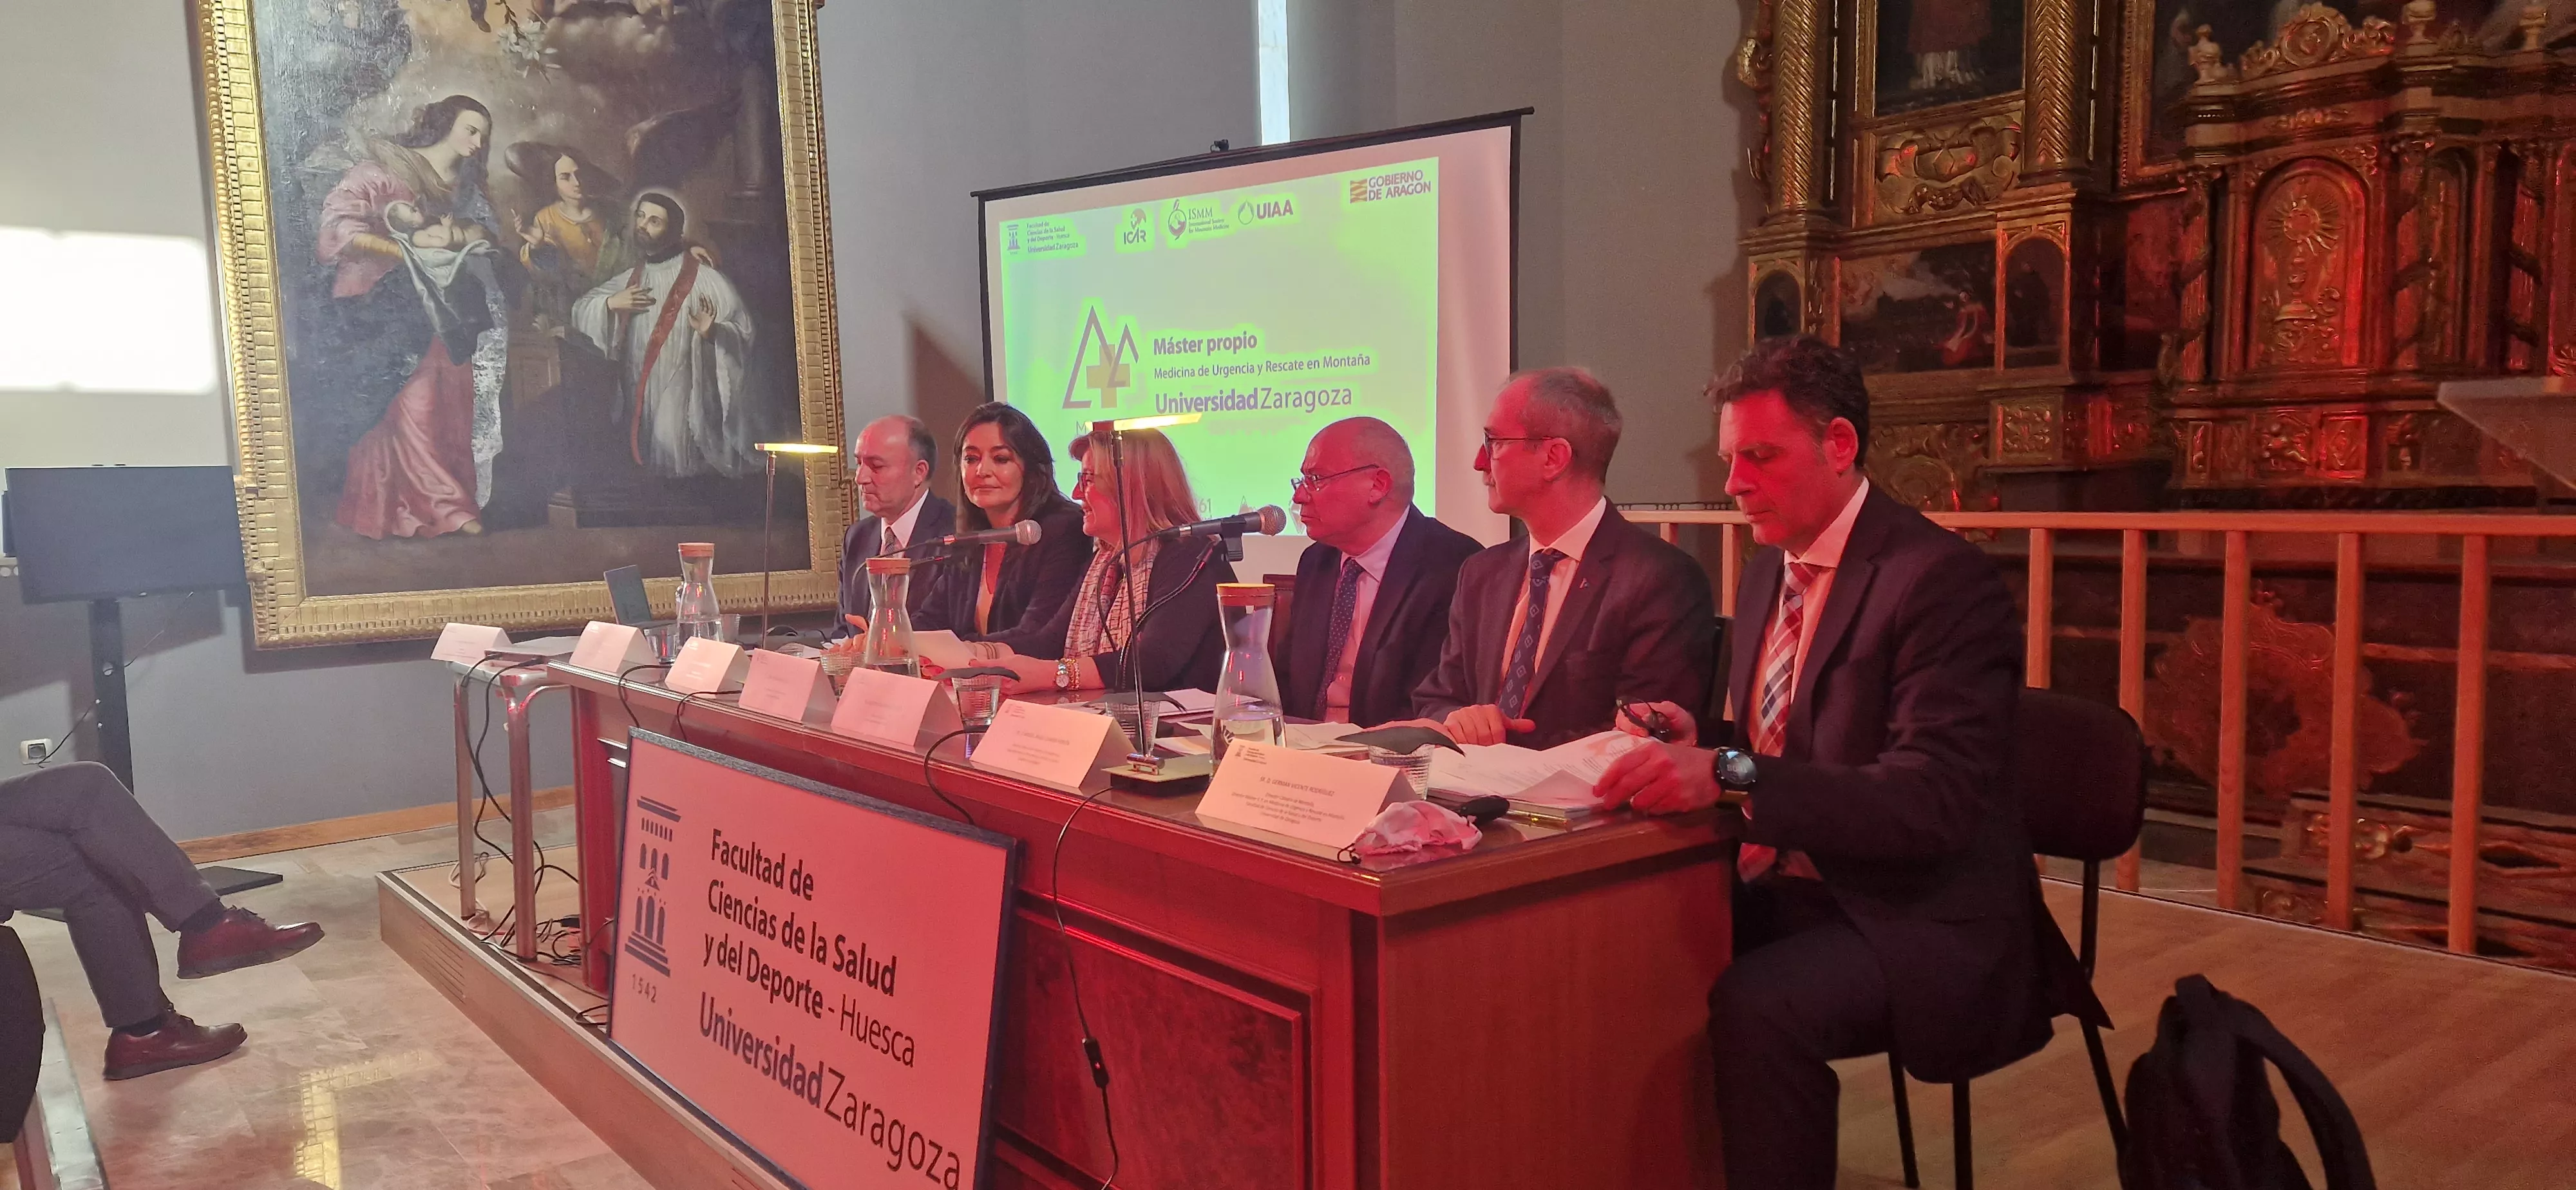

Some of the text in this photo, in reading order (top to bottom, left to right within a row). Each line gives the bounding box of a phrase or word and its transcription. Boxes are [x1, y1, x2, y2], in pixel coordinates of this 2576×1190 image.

[1368, 170, 1423, 188] GOBIERNO
[1368, 180, 1431, 202] DE ARAGON
[1189, 207, 1213, 220] ISMM
[1256, 199, 1294, 220] UIAA
[1123, 227, 1146, 245] ICAR
[1153, 330, 1258, 356] Máster propio
[1154, 353, 1370, 379] Medicina de Urgencia y Rescate en Montaña
[1198, 498, 1212, 513] 61
[712, 828, 814, 902] Facultad de
[708, 879, 896, 997] Ciencias de la Salud
[632, 974, 656, 1003] 1542
[703, 934, 714, 967] y
[717, 933, 743, 976] del
[746, 947, 823, 1019] Deporte
[840, 994, 914, 1068] Huesca
